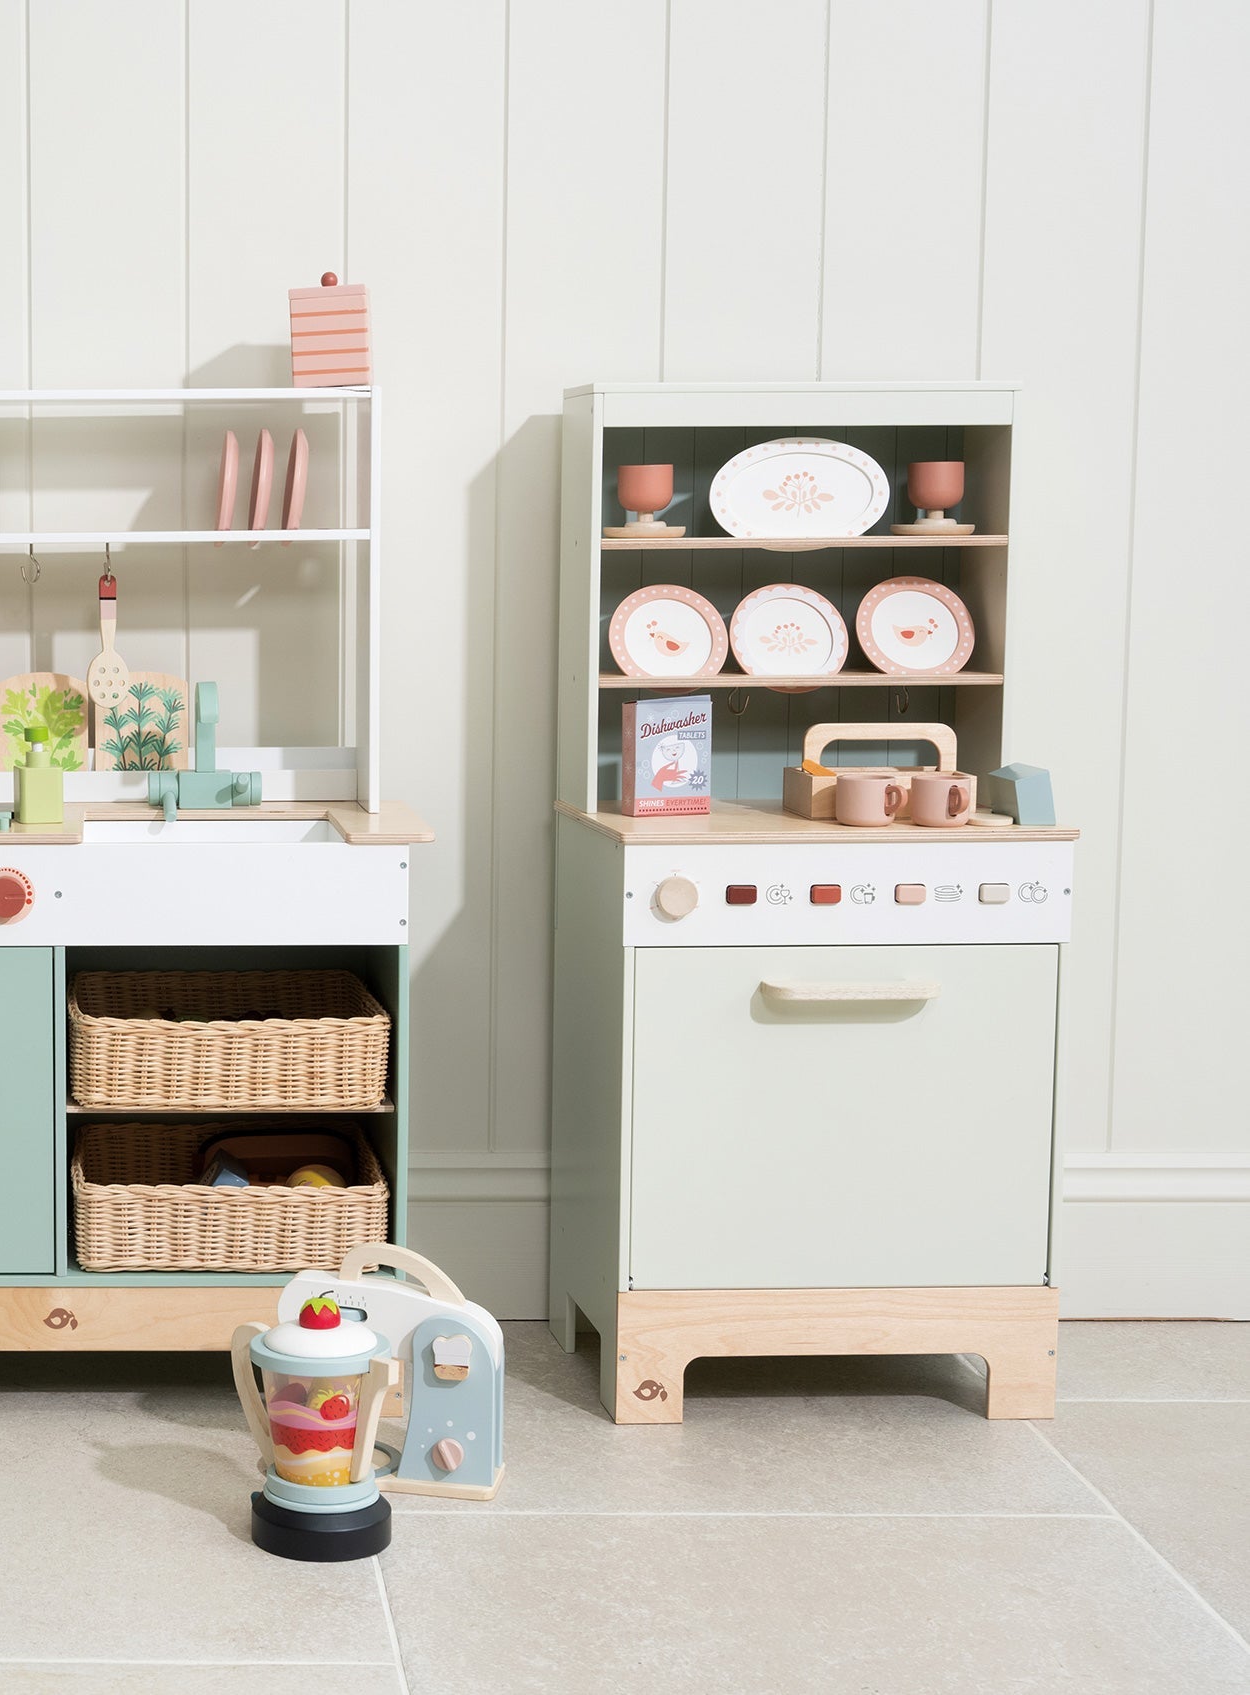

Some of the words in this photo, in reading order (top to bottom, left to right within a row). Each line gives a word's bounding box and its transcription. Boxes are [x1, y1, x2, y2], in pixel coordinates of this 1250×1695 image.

[640, 711, 707, 739] Dishwasher
[679, 731, 705, 739] TABLETS
[692, 775, 704, 784] 20
